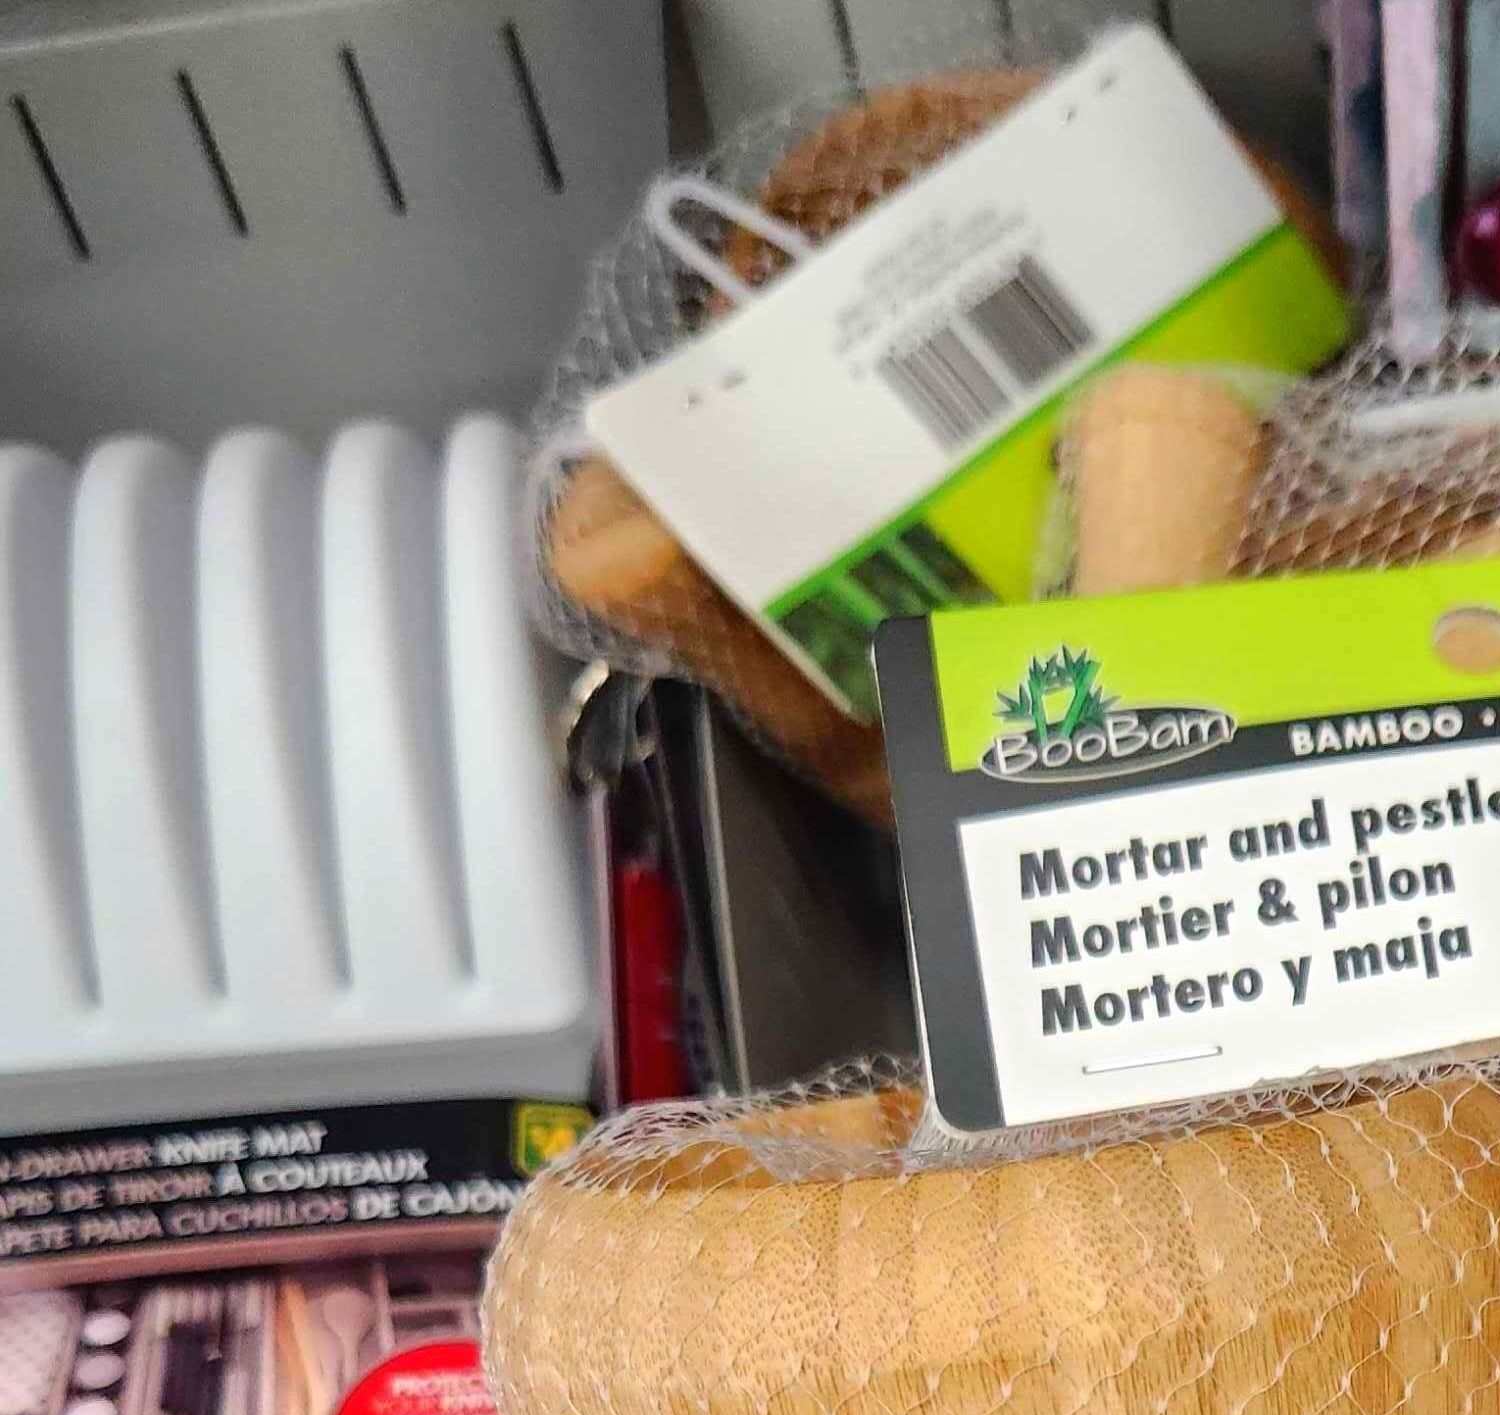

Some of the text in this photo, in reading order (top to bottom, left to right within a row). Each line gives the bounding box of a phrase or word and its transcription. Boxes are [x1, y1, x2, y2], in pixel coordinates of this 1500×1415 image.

[993, 708, 1236, 777] BooBam
[1290, 705, 1465, 757] BAMBOO
[1018, 833, 1208, 900] Mortar
[1228, 798, 1332, 862] and
[1030, 855, 1456, 969] Mortier & pilon
[1040, 915, 1474, 1036] Mortero y maja
[155, 1132, 249, 1168] KNIFE
[252, 1117, 328, 1157] MAT
[247, 1148, 430, 1194] COUTEAUX
[350, 1184, 400, 1220] DE
